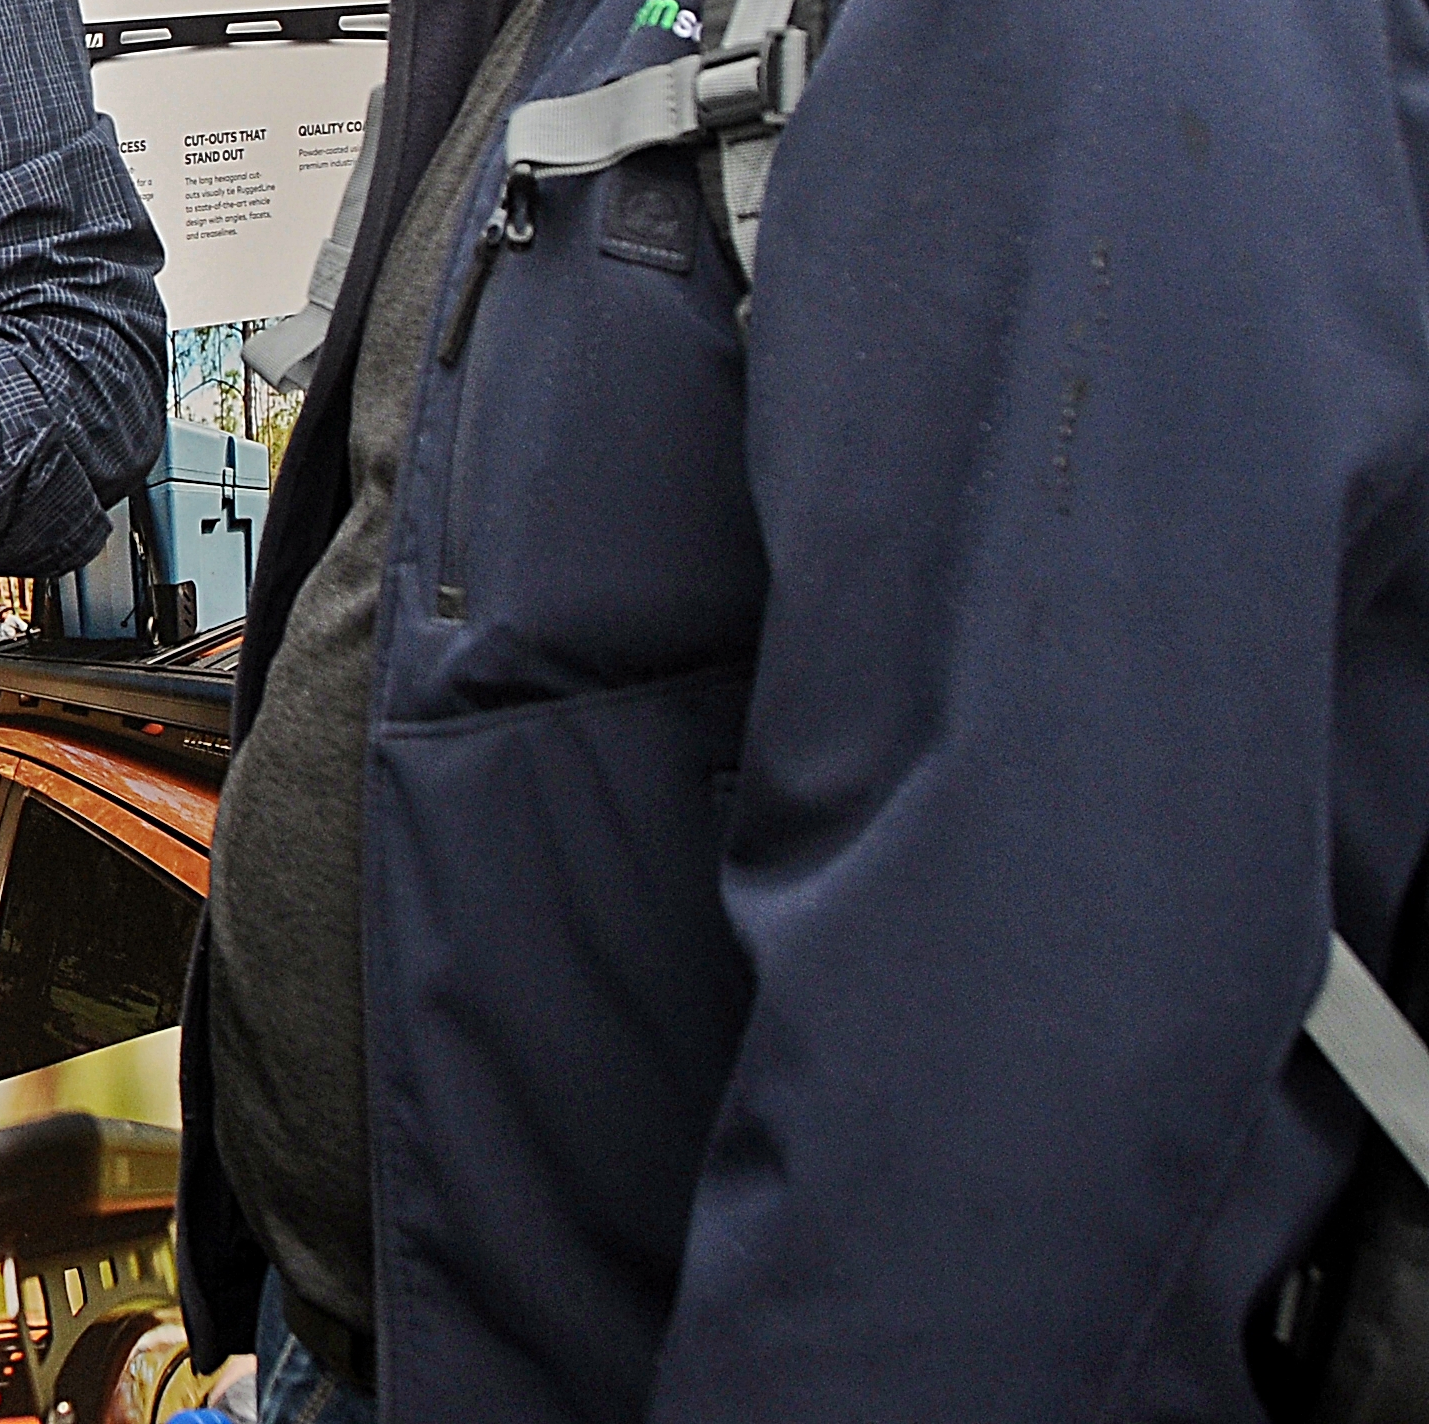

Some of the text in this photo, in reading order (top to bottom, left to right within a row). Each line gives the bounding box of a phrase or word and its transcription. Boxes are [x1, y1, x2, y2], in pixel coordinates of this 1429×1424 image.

[298, 122, 344, 136] QUALITY
[184, 129, 266, 147] CUT-OUTS THAT
[185, 148, 244, 165] STAND OUT
